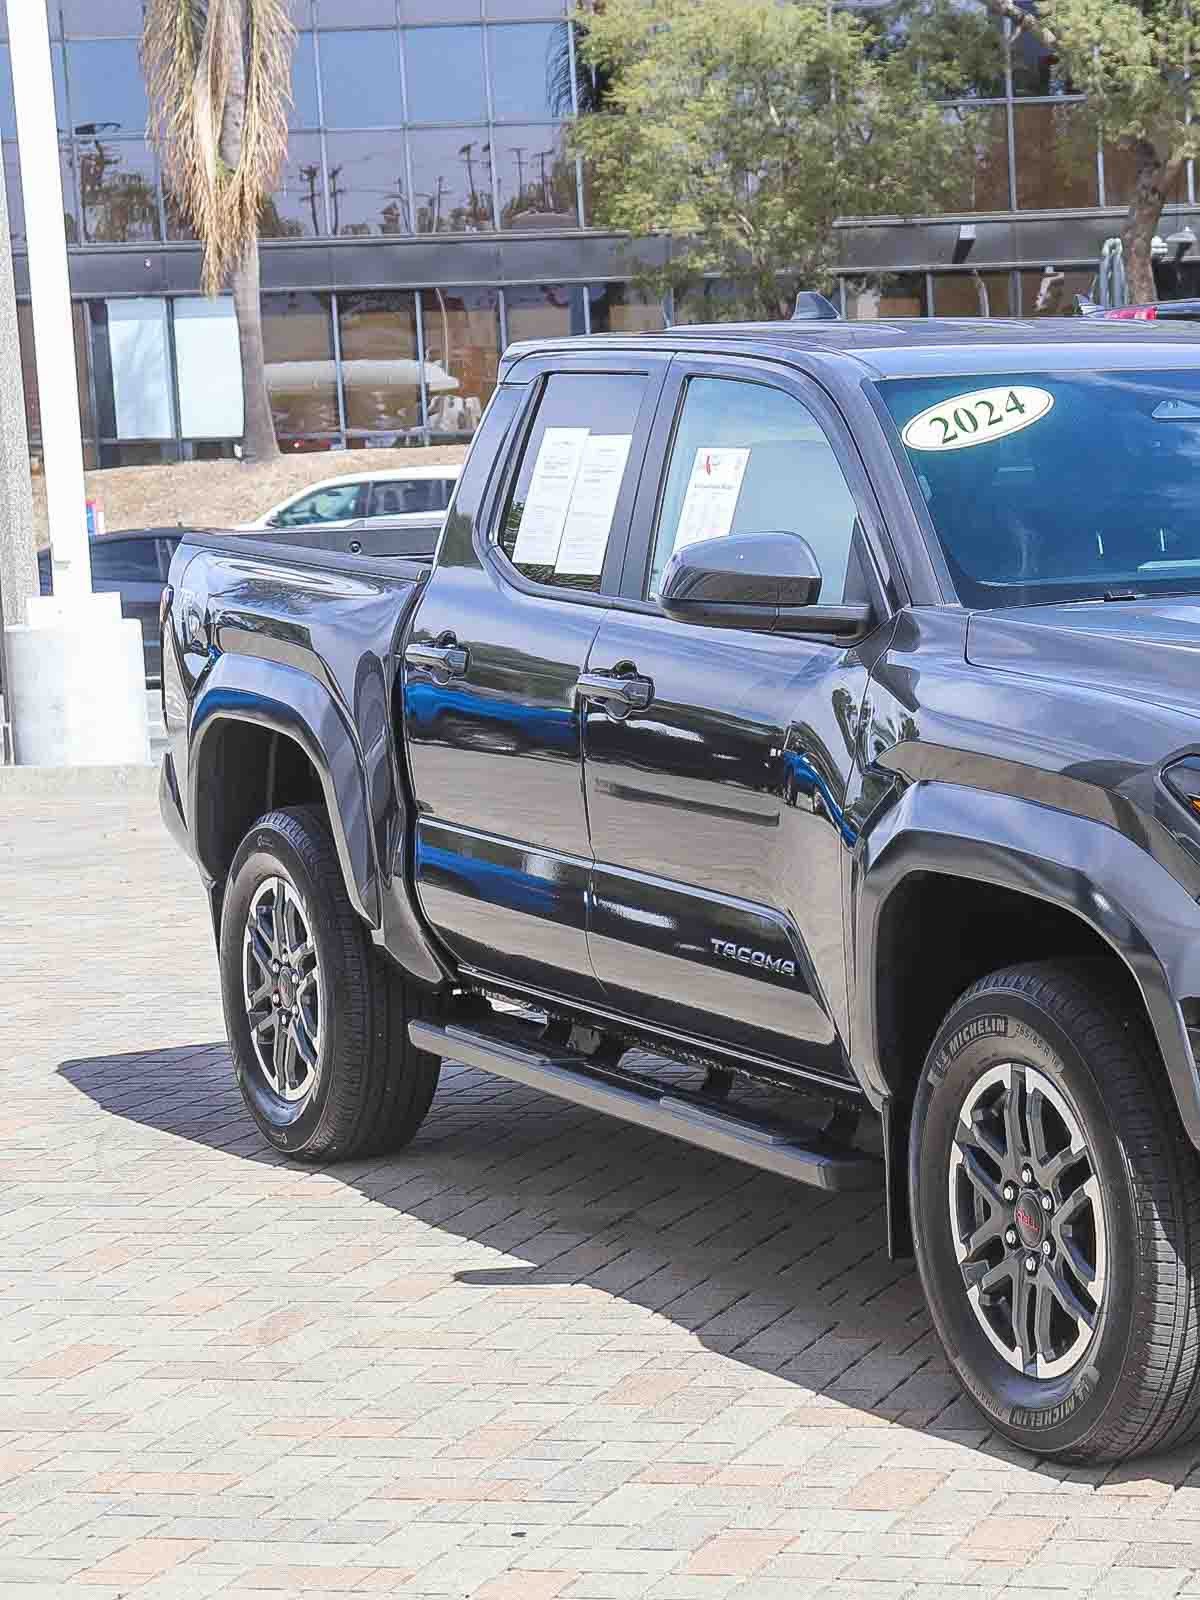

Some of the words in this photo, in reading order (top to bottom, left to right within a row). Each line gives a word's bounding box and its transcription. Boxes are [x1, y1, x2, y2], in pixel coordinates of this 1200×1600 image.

[929, 390, 1025, 444] 2024
[711, 938, 796, 976] TACOMA
[949, 1018, 1006, 1057] MICHELIN
[1013, 1395, 1075, 1427] MICHELIN
